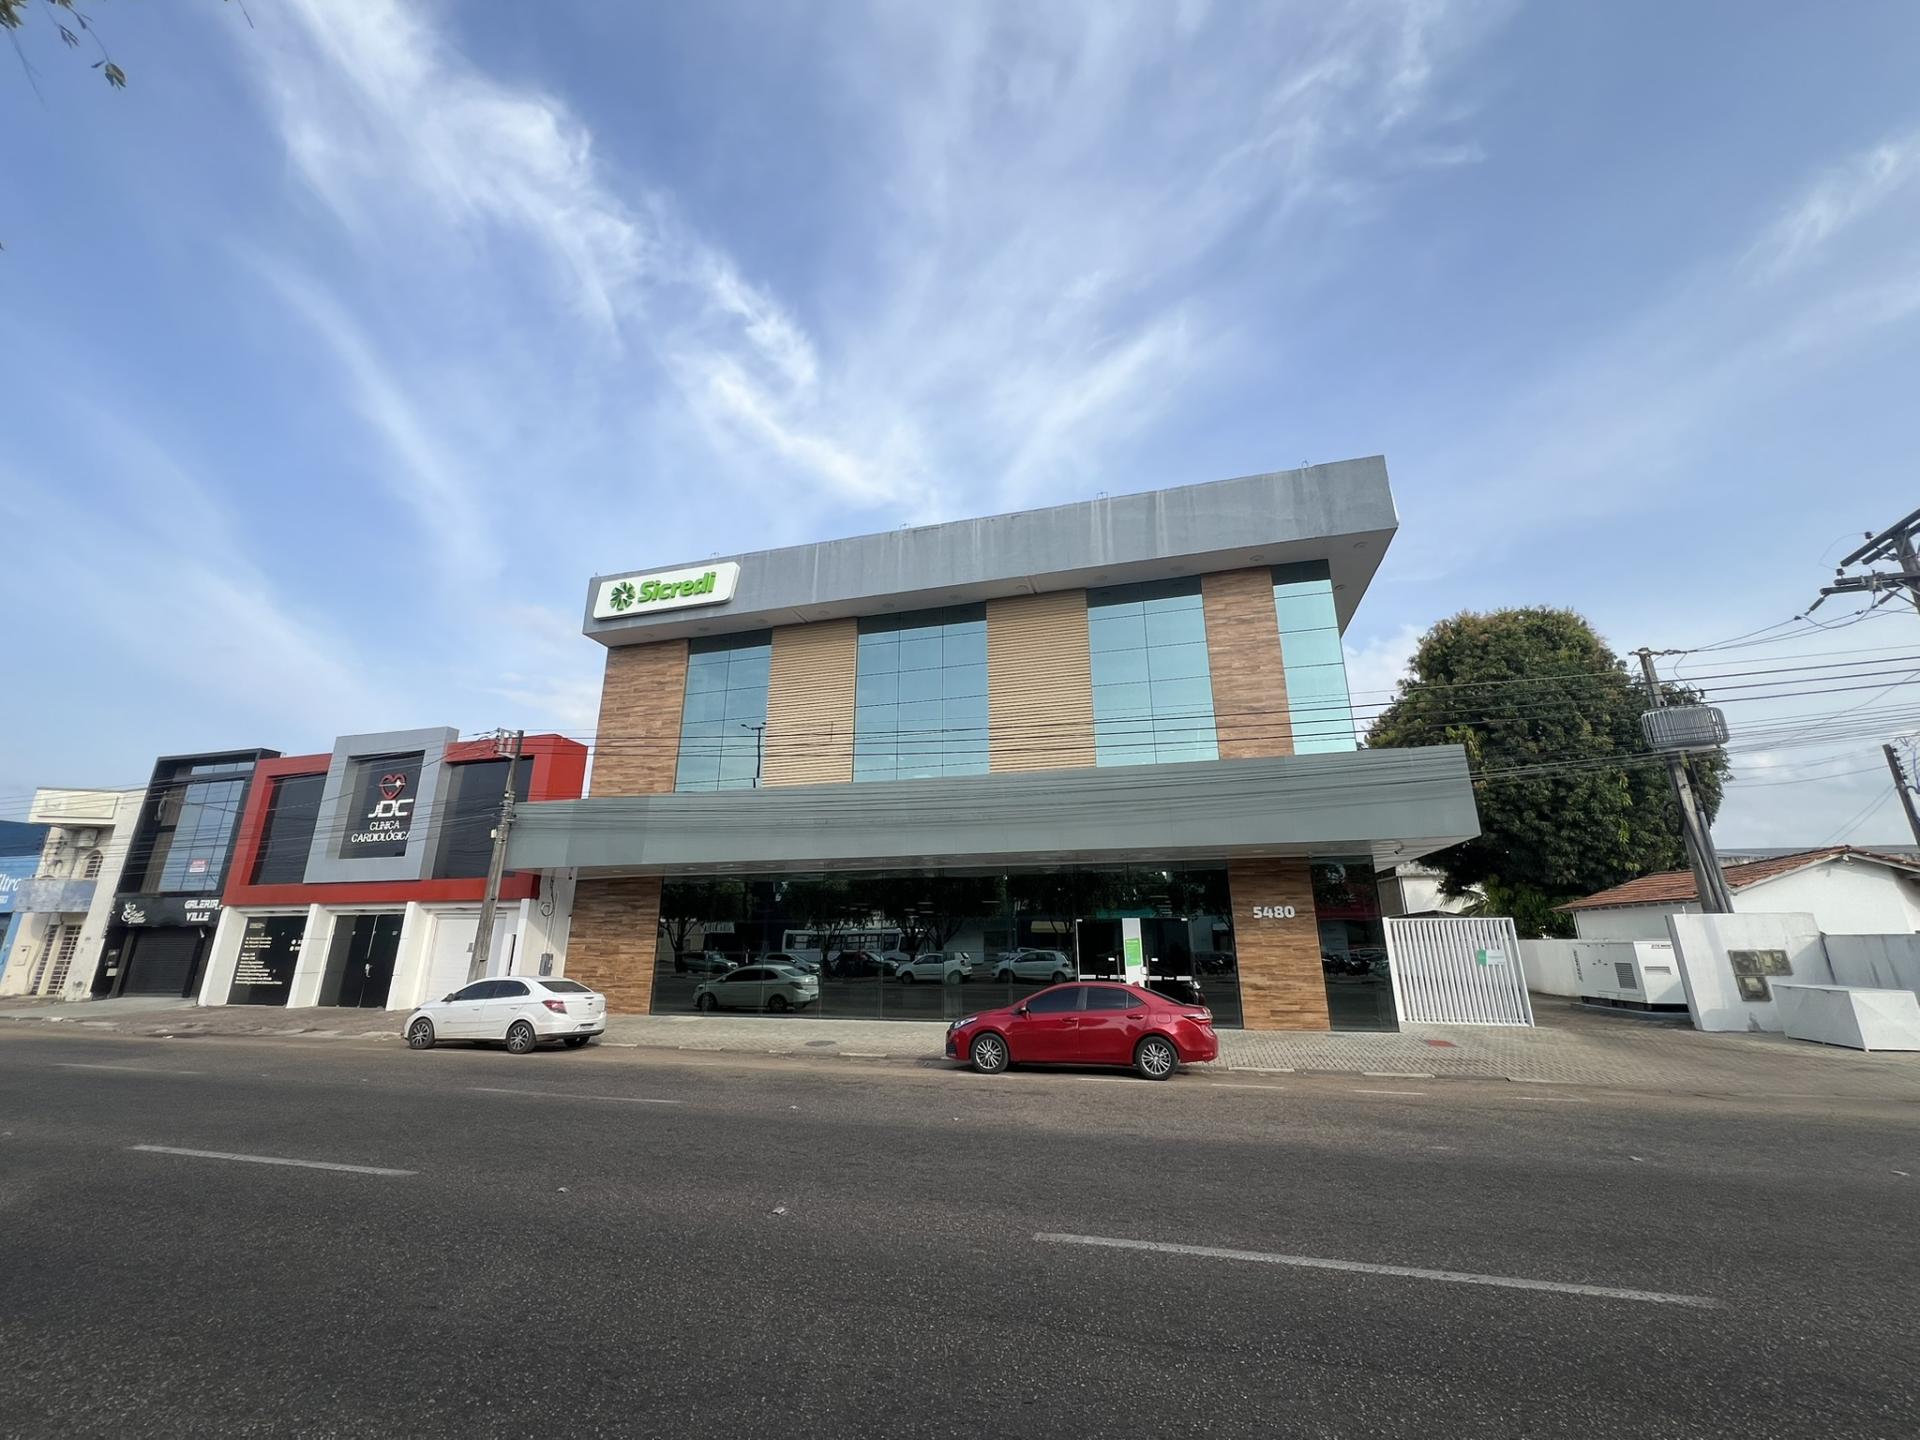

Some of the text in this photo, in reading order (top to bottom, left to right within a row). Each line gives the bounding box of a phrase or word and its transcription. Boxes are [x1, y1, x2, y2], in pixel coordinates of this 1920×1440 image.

[638, 571, 716, 602] Sicredi
[367, 798, 414, 818] JDC
[184, 899, 220, 910] GALERIA
[186, 911, 211, 922] VILLE
[1252, 905, 1296, 919] 5480
